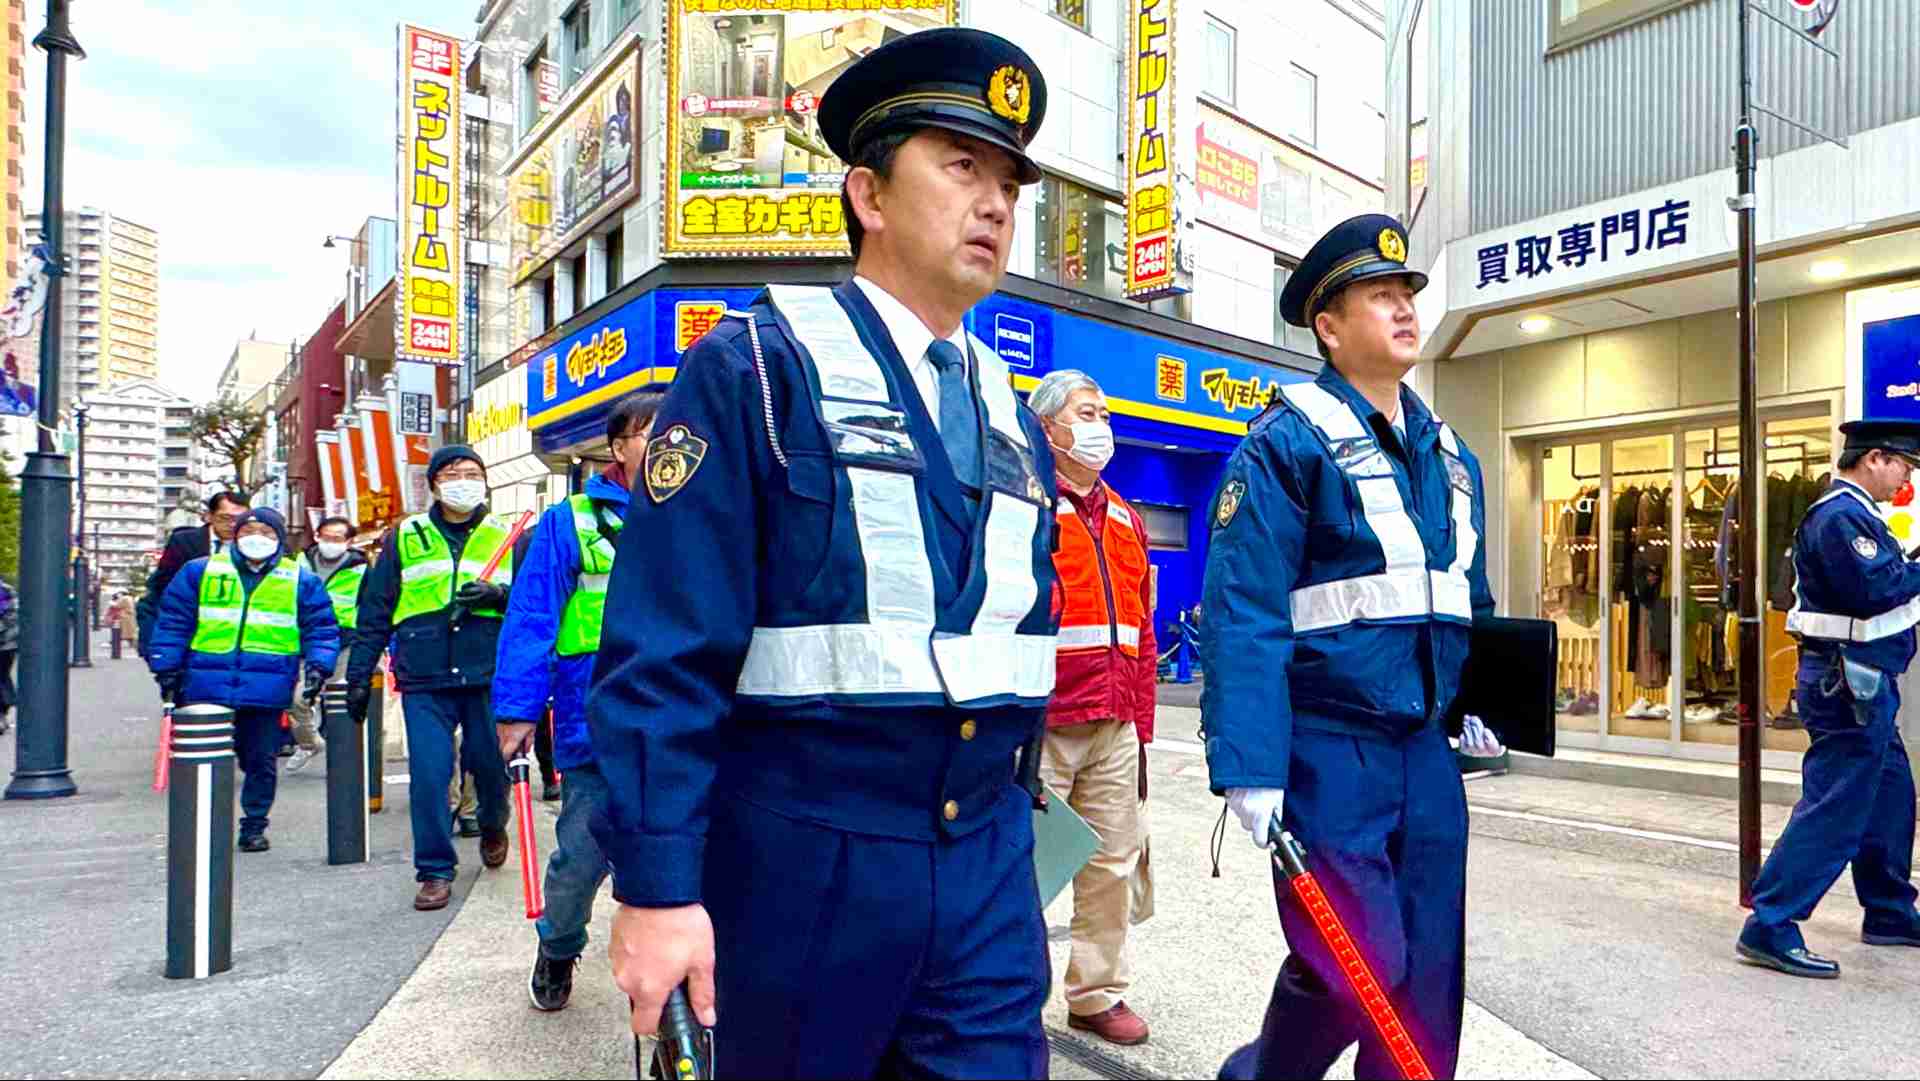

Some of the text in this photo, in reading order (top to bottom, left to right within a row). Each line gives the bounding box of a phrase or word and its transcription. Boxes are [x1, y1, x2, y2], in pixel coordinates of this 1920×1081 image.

[413, 50, 451, 71] 2F
[413, 79, 451, 273] ネットルーム
[683, 193, 848, 235] 全室カギ付
[1136, 241, 1166, 264] 24H
[1475, 199, 1691, 289] 買取専門店
[1136, 258, 1166, 277] OPEN
[413, 322, 449, 339] 24H
[413, 336, 449, 350] OPEN
[1159, 360, 1183, 397] 薬
